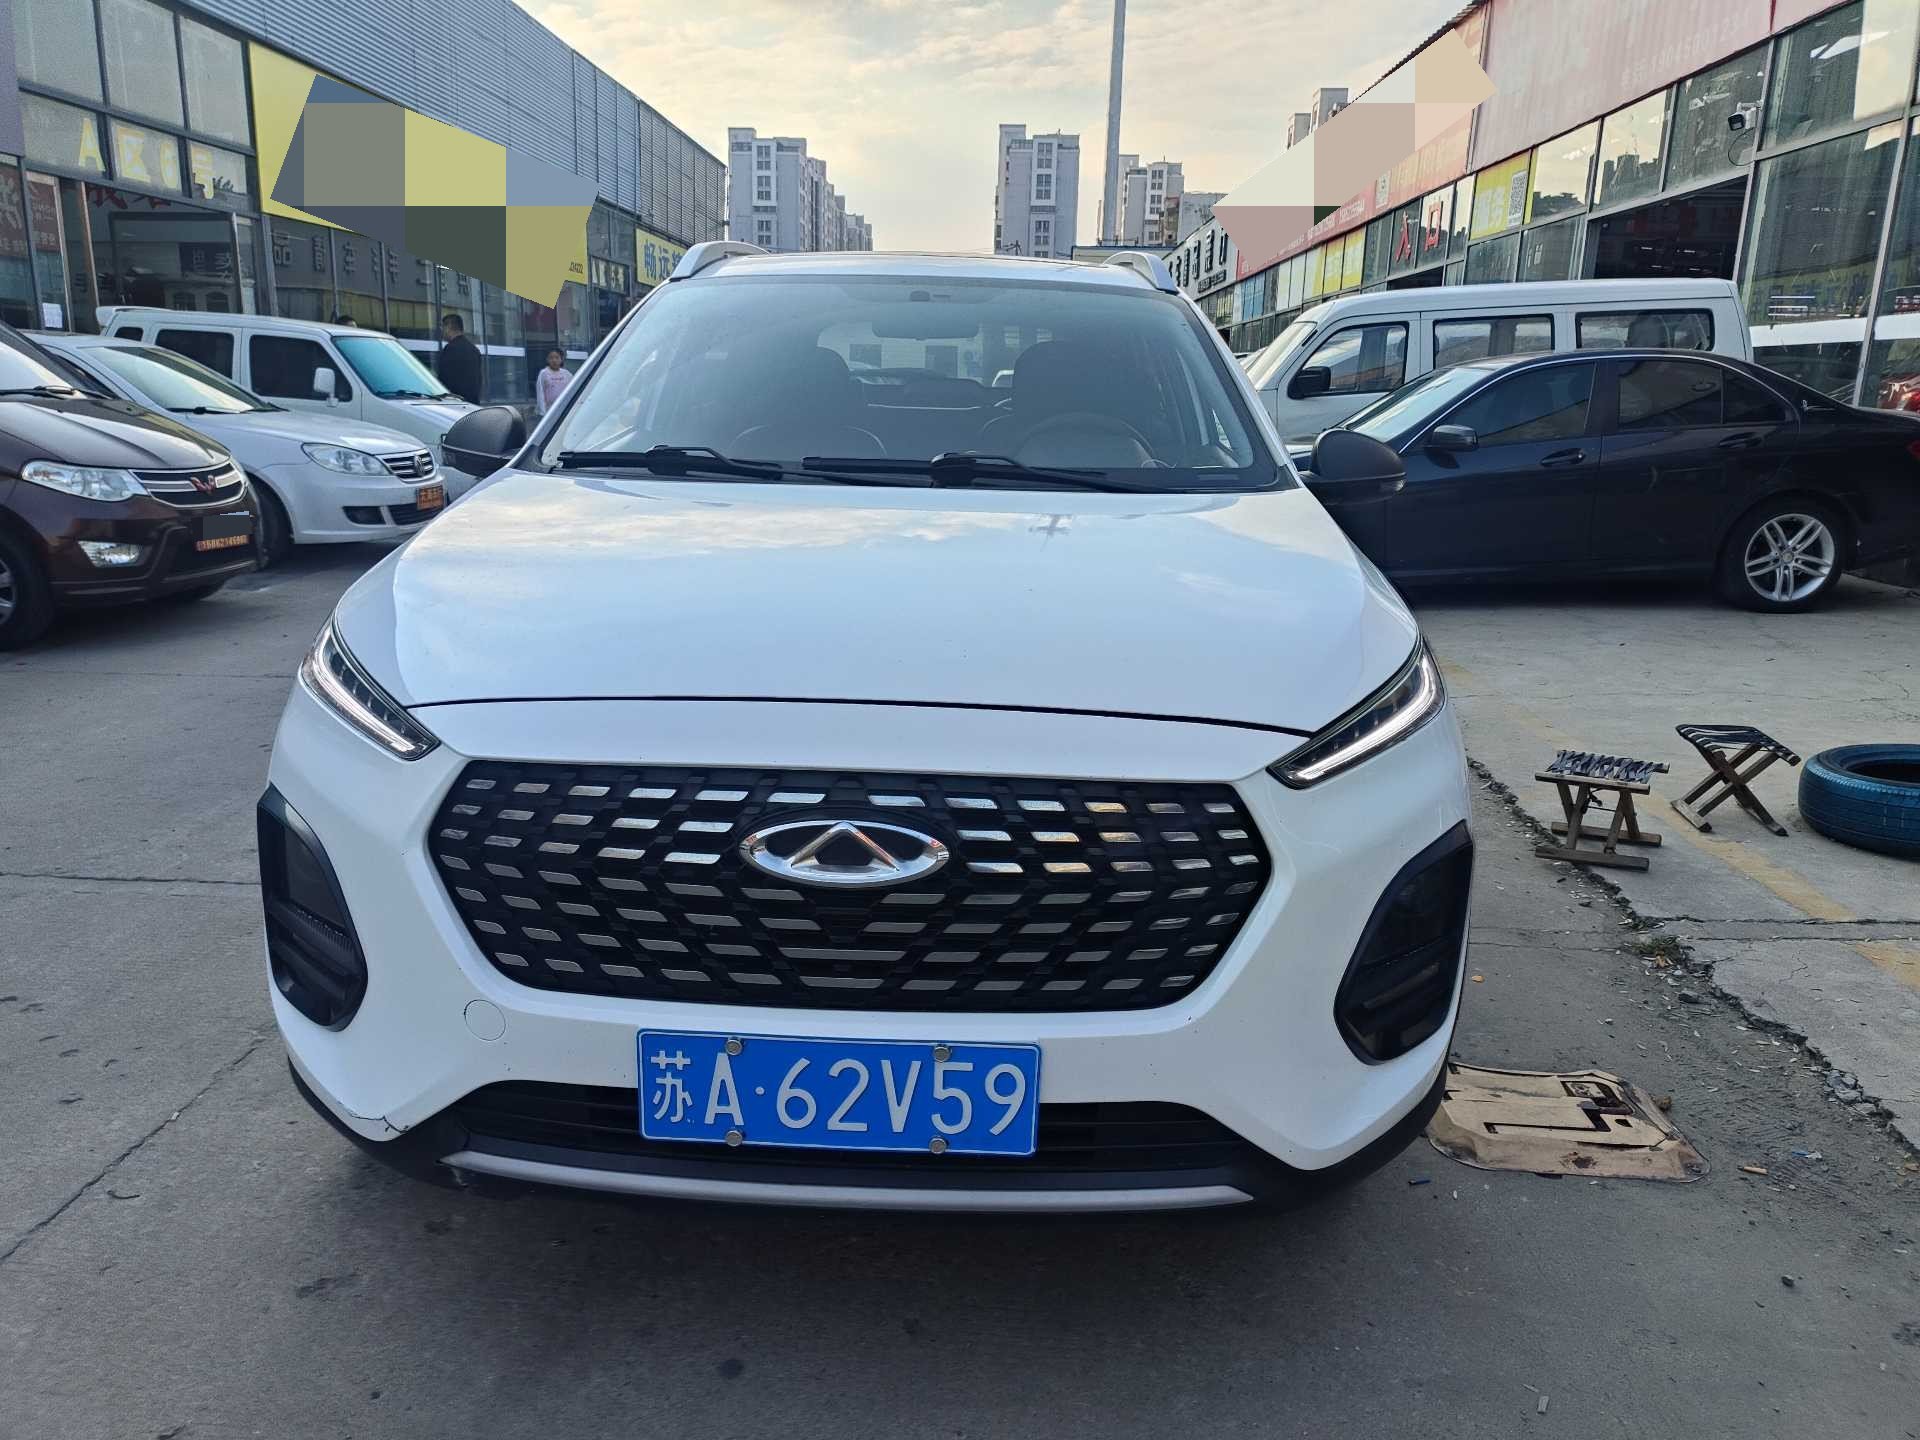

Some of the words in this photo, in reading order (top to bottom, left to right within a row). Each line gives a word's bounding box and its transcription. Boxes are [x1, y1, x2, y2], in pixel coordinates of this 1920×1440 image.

[78, 117, 215, 200] A区6号
[1395, 200, 1444, 263] 入口
[650, 1050, 1027, 1137] 苏A·62V59
